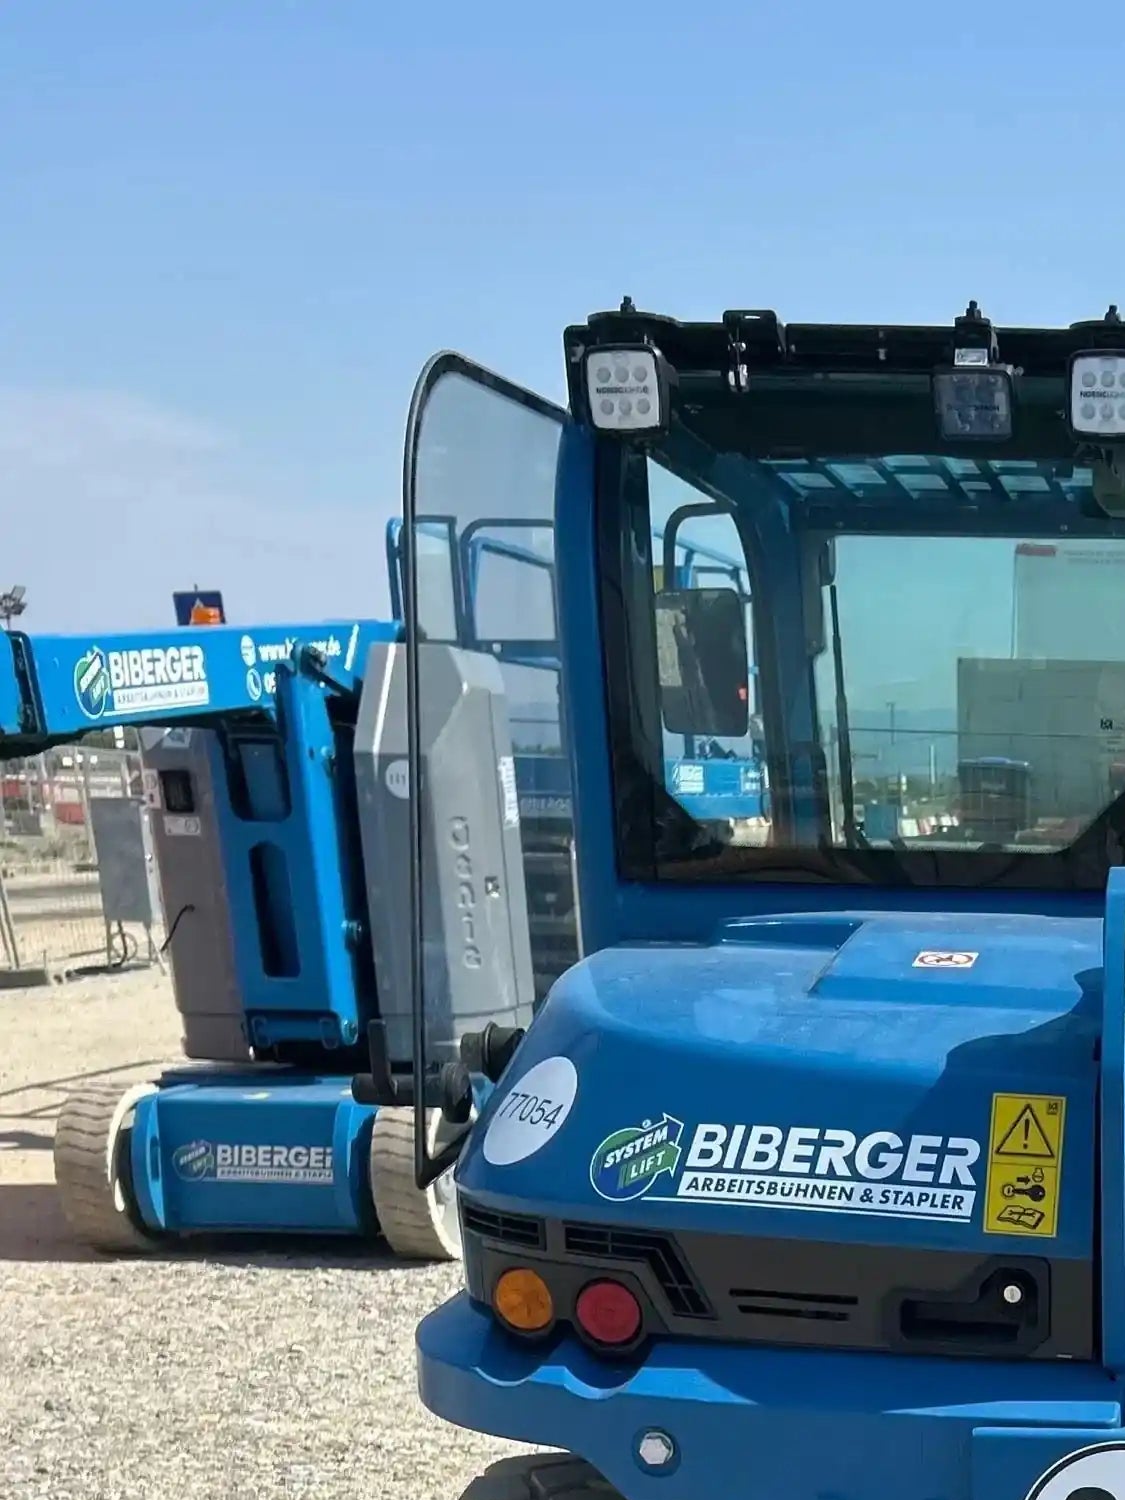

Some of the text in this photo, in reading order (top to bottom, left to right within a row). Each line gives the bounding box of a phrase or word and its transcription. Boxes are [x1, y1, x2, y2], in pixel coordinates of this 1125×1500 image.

[108, 645, 206, 688] BIBERGER
[499, 1091, 564, 1130] 77054
[603, 1125, 669, 1169] SYSTEM
[630, 1150, 666, 1179] LIFT
[685, 1123, 981, 1187] BIBERGER
[686, 1176, 965, 1211] ARBEITSBÜHNEN & STAPLER
